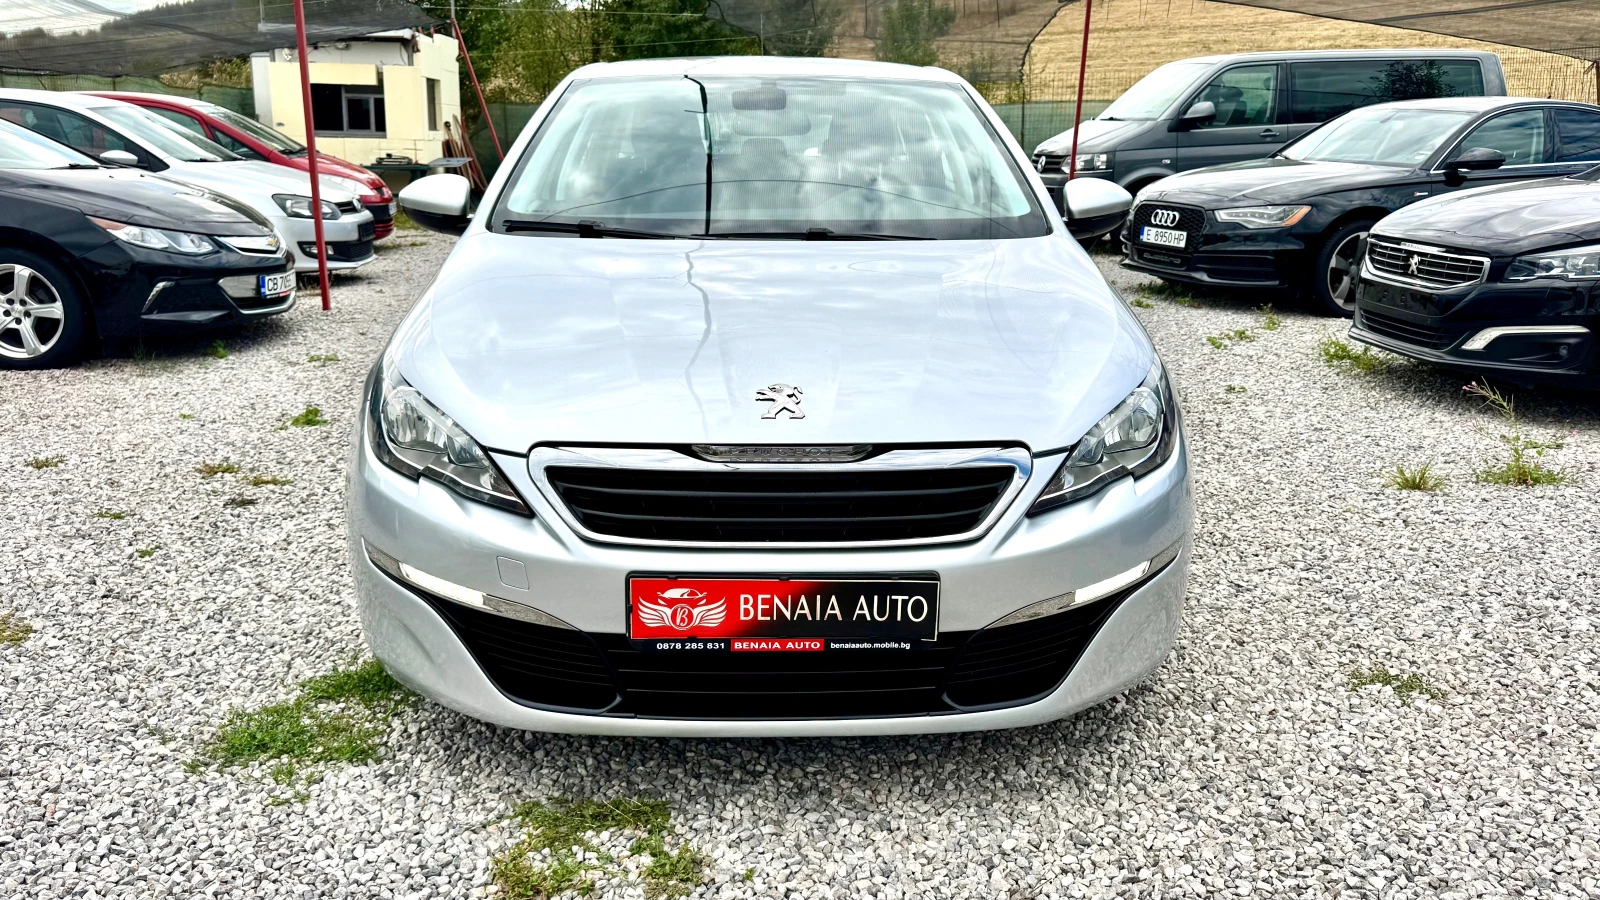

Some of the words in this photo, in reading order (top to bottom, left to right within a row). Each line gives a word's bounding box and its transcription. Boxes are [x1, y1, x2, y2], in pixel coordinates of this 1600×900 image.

[739, 594, 843, 621] BENAIA
[853, 595, 928, 622] AUTO
[656, 642, 682, 650] 0878
[684, 642, 704, 650] 285
[706, 642, 725, 650] 831
[734, 641, 781, 649] BENAIA
[785, 641, 821, 649] AUTO
[830, 641, 911, 650] benaiaauto.mobile.bg
